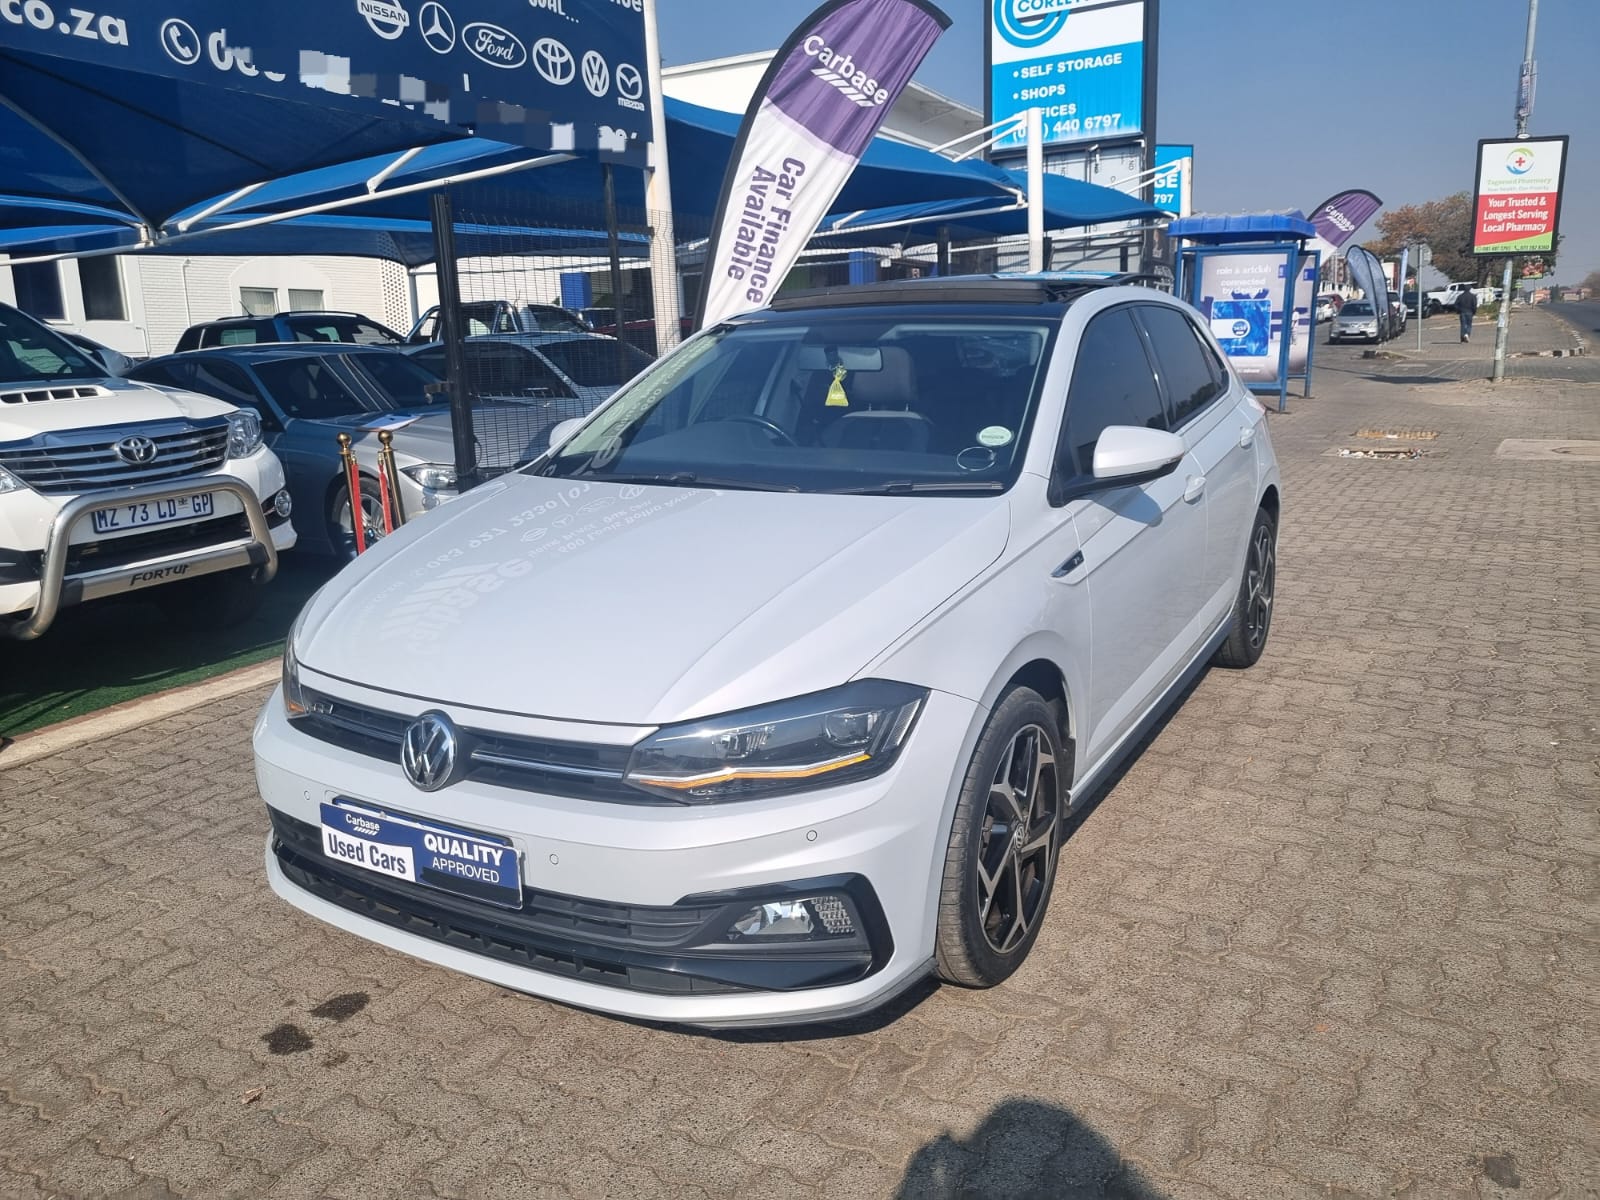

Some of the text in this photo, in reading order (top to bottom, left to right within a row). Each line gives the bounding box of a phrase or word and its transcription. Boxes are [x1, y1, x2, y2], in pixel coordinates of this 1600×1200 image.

[360, 2, 407, 23] NISSAN
[475, 29, 515, 61] Ford
[803, 35, 889, 105] Carbase
[1021, 53, 1123, 79] SELF STORAGE
[1020, 84, 1066, 100] SHOPS
[1053, 118, 1080, 133] 440
[1084, 113, 1122, 130] 6797
[1154, 194, 1174, 204] 797
[1488, 196, 1546, 207] Your Trusted &
[727, 165, 778, 281] Available
[1483, 222, 1547, 233] Local Pharmacy
[1484, 209, 1549, 222] Longest Serving
[746, 157, 806, 303] Car Finance
[96, 493, 210, 529] MZ 73 LD GP
[345, 813, 380, 832] Carbase
[328, 832, 407, 875] Used Cars
[424, 834, 504, 866] QUALITY
[432, 856, 500, 884] APPROVED
